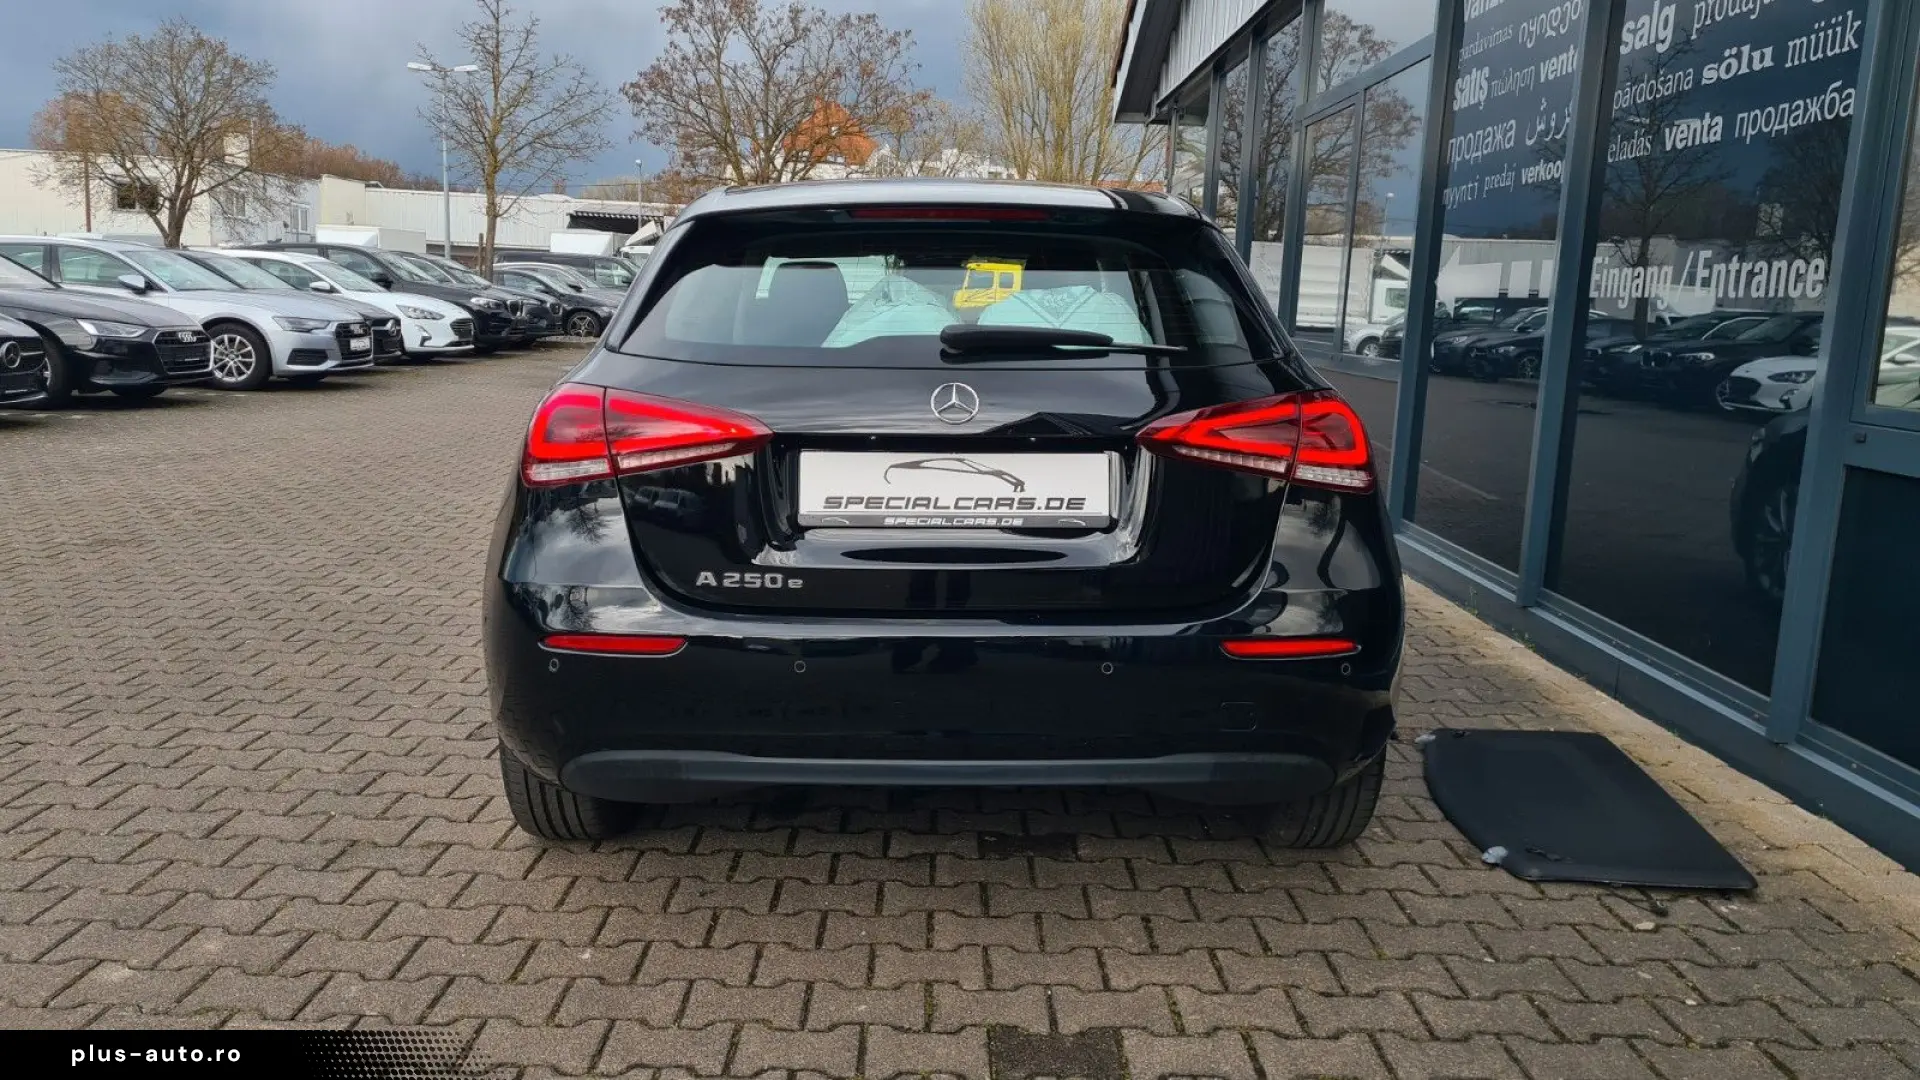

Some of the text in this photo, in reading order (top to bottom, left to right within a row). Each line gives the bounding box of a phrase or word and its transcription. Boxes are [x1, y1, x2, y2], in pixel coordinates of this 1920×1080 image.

[1620, 0, 1676, 54] salg
[1612, 10, 1862, 118] pārdošana sölu müük
[1446, 119, 1516, 171] продажа
[1607, 80, 1856, 163] eladás venta продажба
[1482, 162, 1517, 198] predaj
[1589, 256, 1674, 309] Eingang
[1695, 249, 1825, 299] Entrance
[822, 496, 1086, 511] SPECIALCARS.DE
